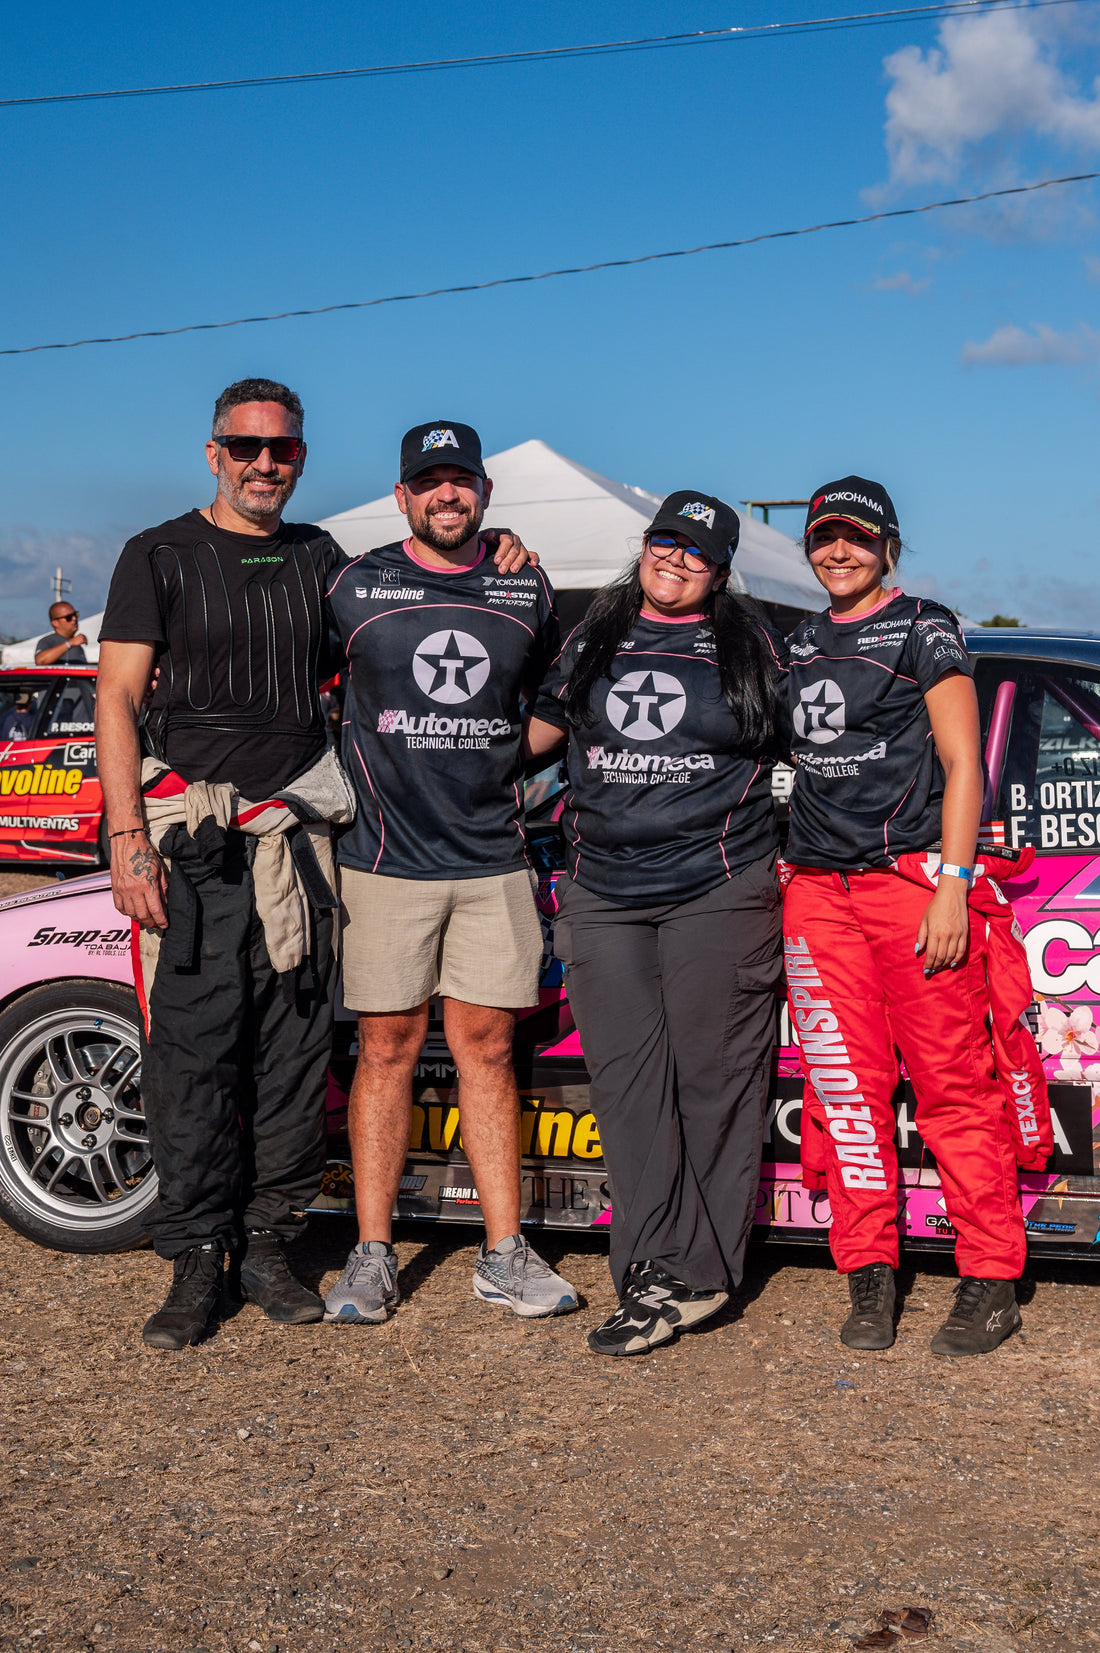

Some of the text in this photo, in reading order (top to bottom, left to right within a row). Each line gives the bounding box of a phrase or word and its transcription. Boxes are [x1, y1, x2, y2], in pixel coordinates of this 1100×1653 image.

[825, 491, 884, 516] YOKOHAMA
[240, 556, 284, 564] PARAGON
[494, 578, 538, 588] YOKOHAMA
[370, 587, 425, 600] Havoline
[509, 591, 537, 600] STAR
[872, 618, 912, 630] YOKOHAMA
[881, 632, 908, 641] STAR
[388, 709, 511, 736] Automeca
[406, 737, 456, 749] TECHNICAL
[591, 746, 716, 772] Automeca
[821, 764, 860, 778] COLLEGE
[1010, 783, 1034, 812] B.
[1010, 815, 1033, 849] F.
[522, 1176, 590, 1211] THE
